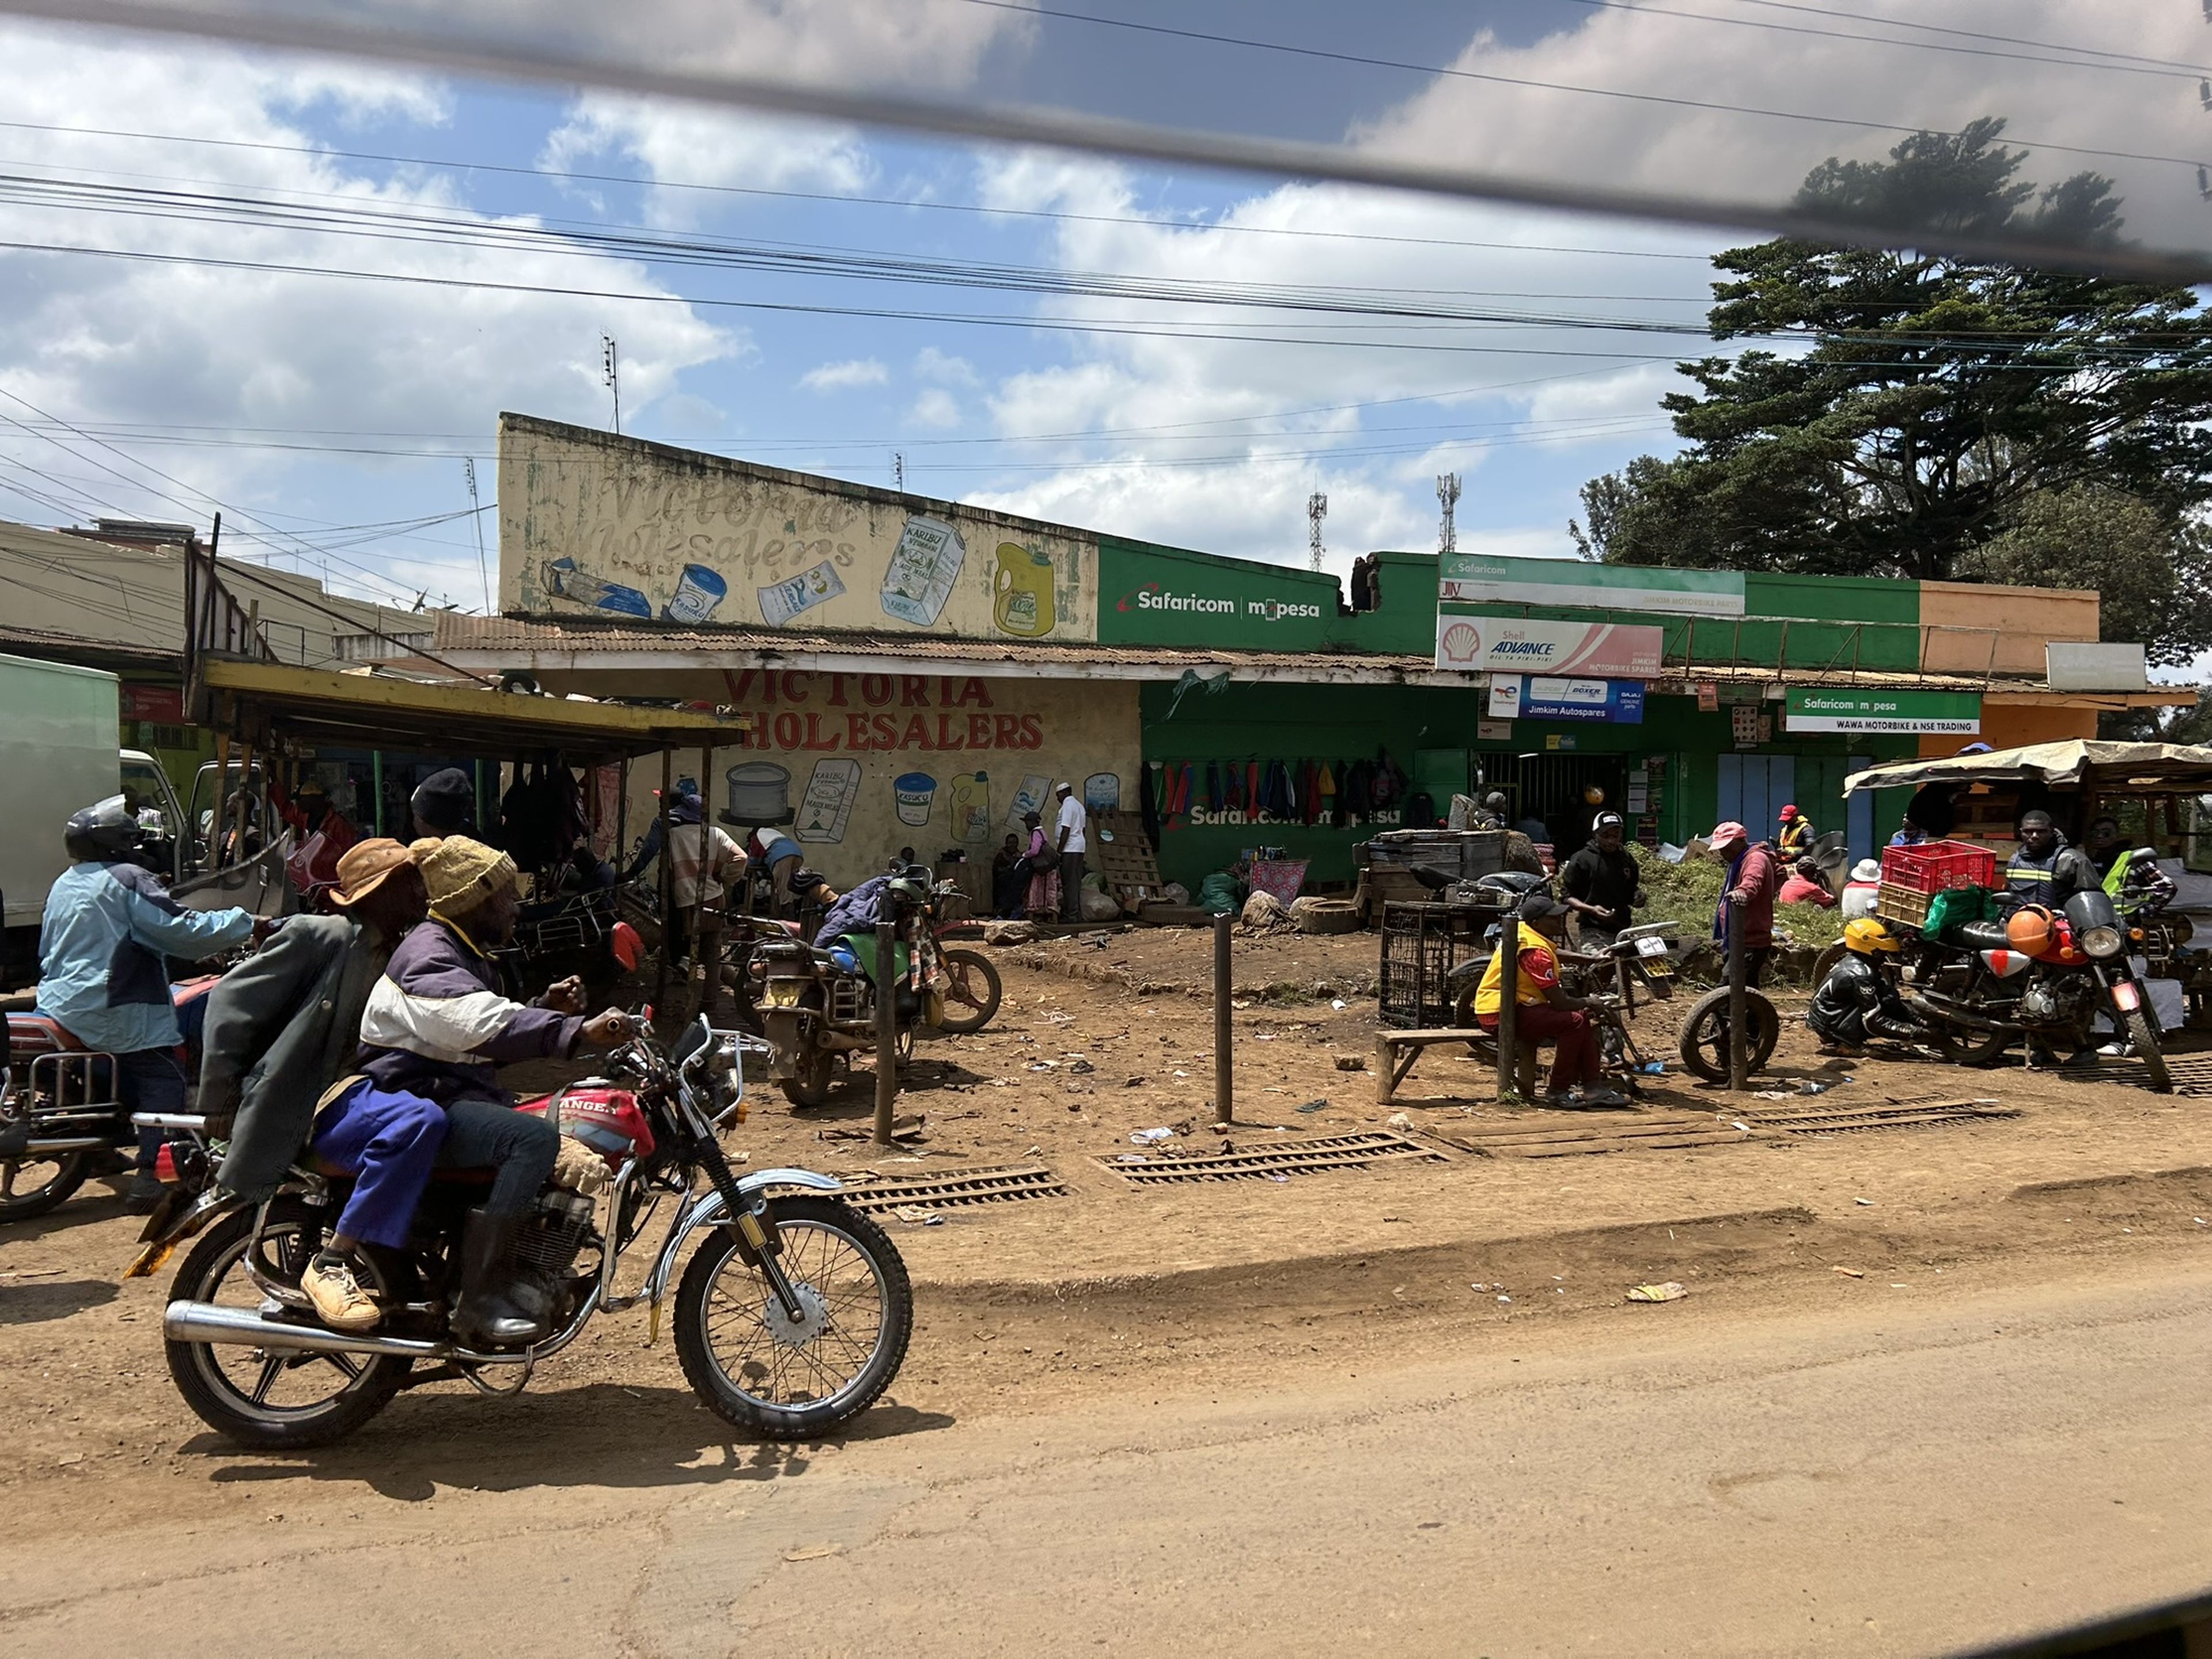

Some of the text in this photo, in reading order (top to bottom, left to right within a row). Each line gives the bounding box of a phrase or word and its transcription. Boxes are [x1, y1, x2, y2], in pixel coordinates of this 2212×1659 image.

[906, 527, 942, 544] KARIBU
[1458, 562, 1506, 575] Safaricom
[674, 597, 705, 618] KASUKU
[1138, 591, 1234, 614] Safaricom
[1502, 631, 1525, 640] Shell
[1491, 641, 1556, 656] ADVANCE
[1631, 657, 1657, 665] JIMKIM
[1589, 664, 1657, 674] MOTORBIKE SPARES
[721, 669, 994, 708] VICTORIA
[1804, 698, 1854, 710] Safaricom
[1528, 706, 1605, 718] Jimkim Autospares
[722, 711, 1044, 751] HOLESALERS
[1836, 720, 1972, 732] WAWA MOTORBIKE & NSE TRADING
